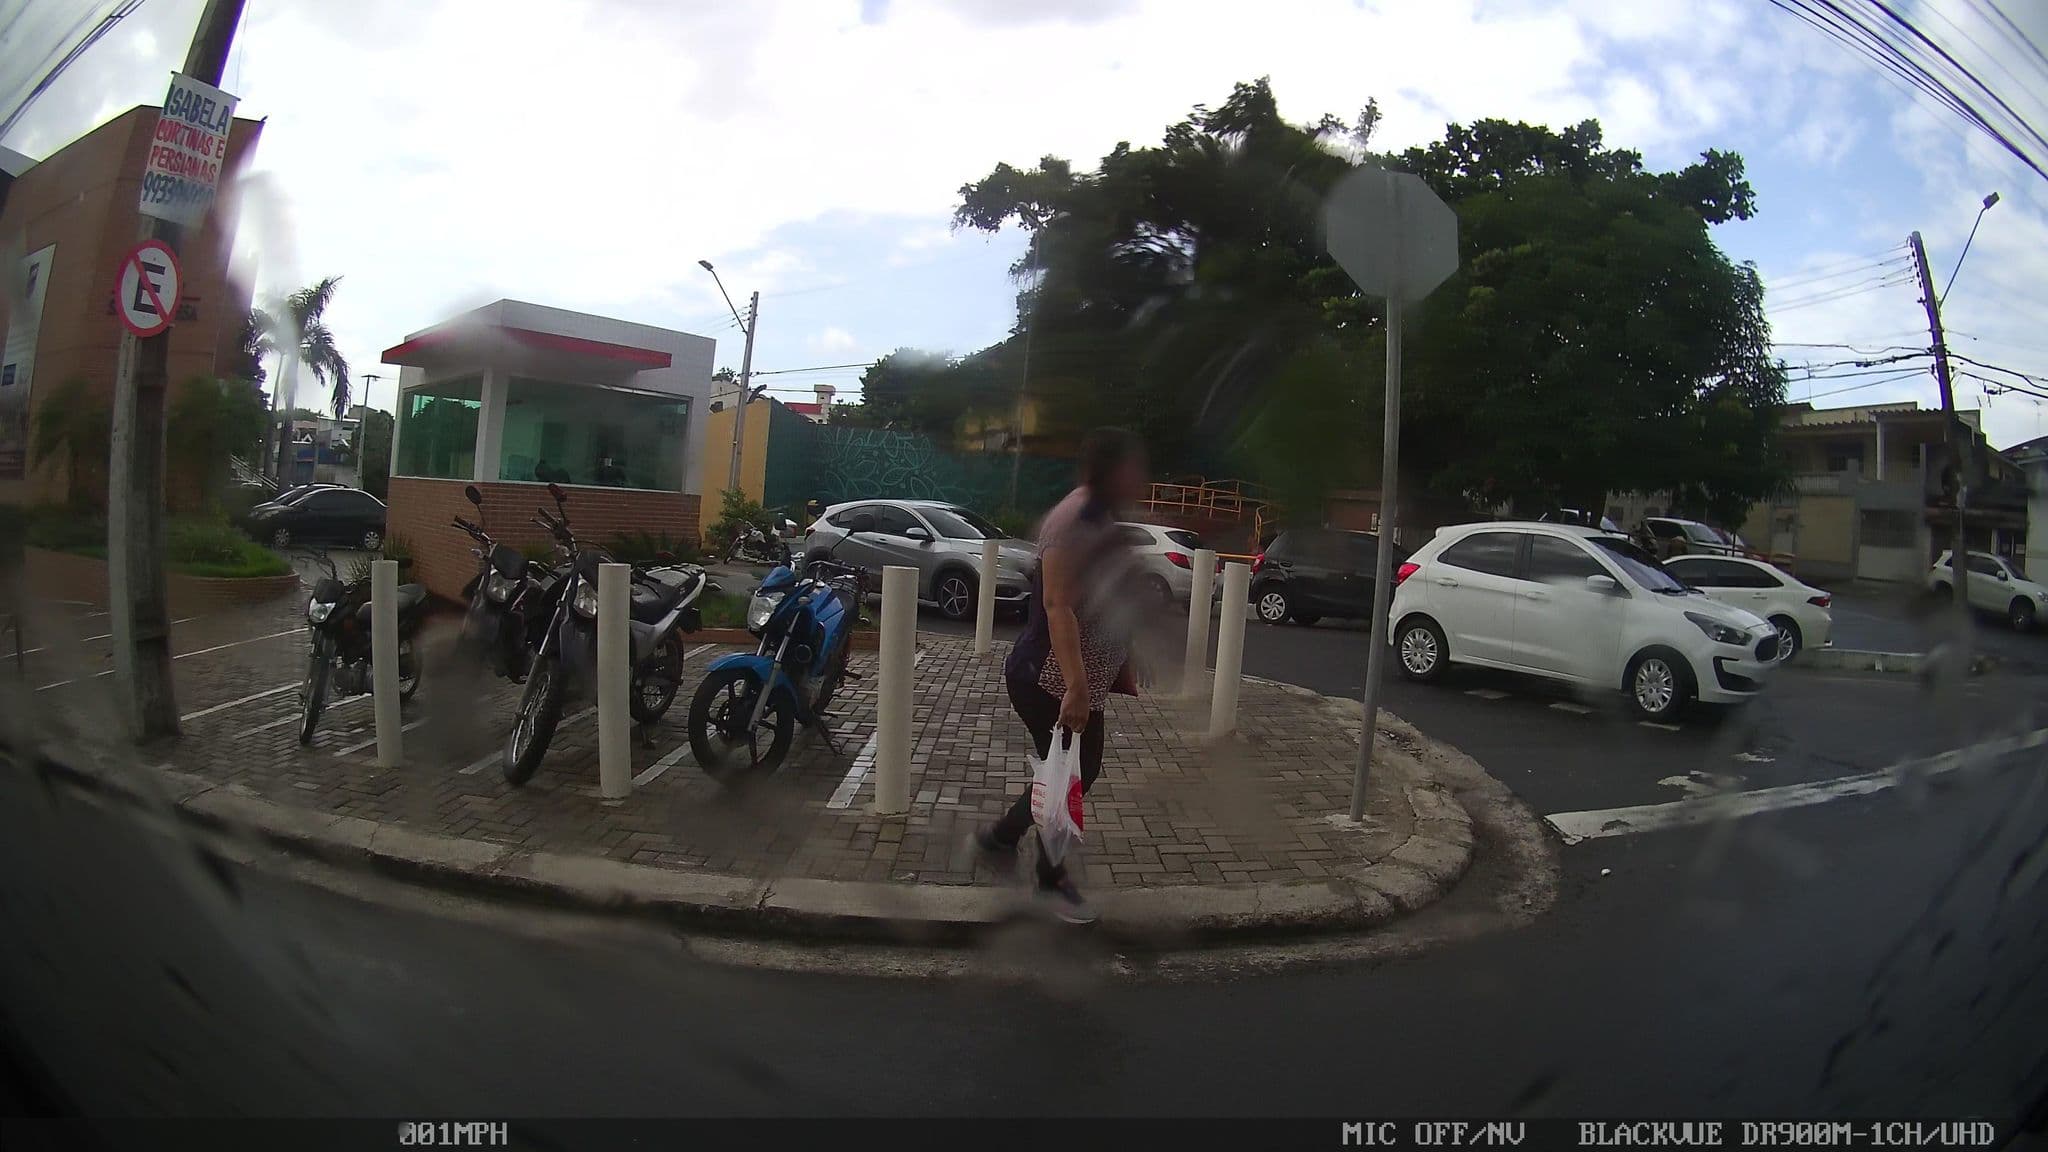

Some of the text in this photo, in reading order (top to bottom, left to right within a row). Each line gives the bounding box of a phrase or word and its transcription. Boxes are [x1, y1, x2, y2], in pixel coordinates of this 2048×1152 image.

[163, 83, 230, 136] ISABELA
[156, 119, 226, 159] CORTINAS E
[149, 145, 218, 183] PERSIANAS
[133, 261, 166, 315] E
